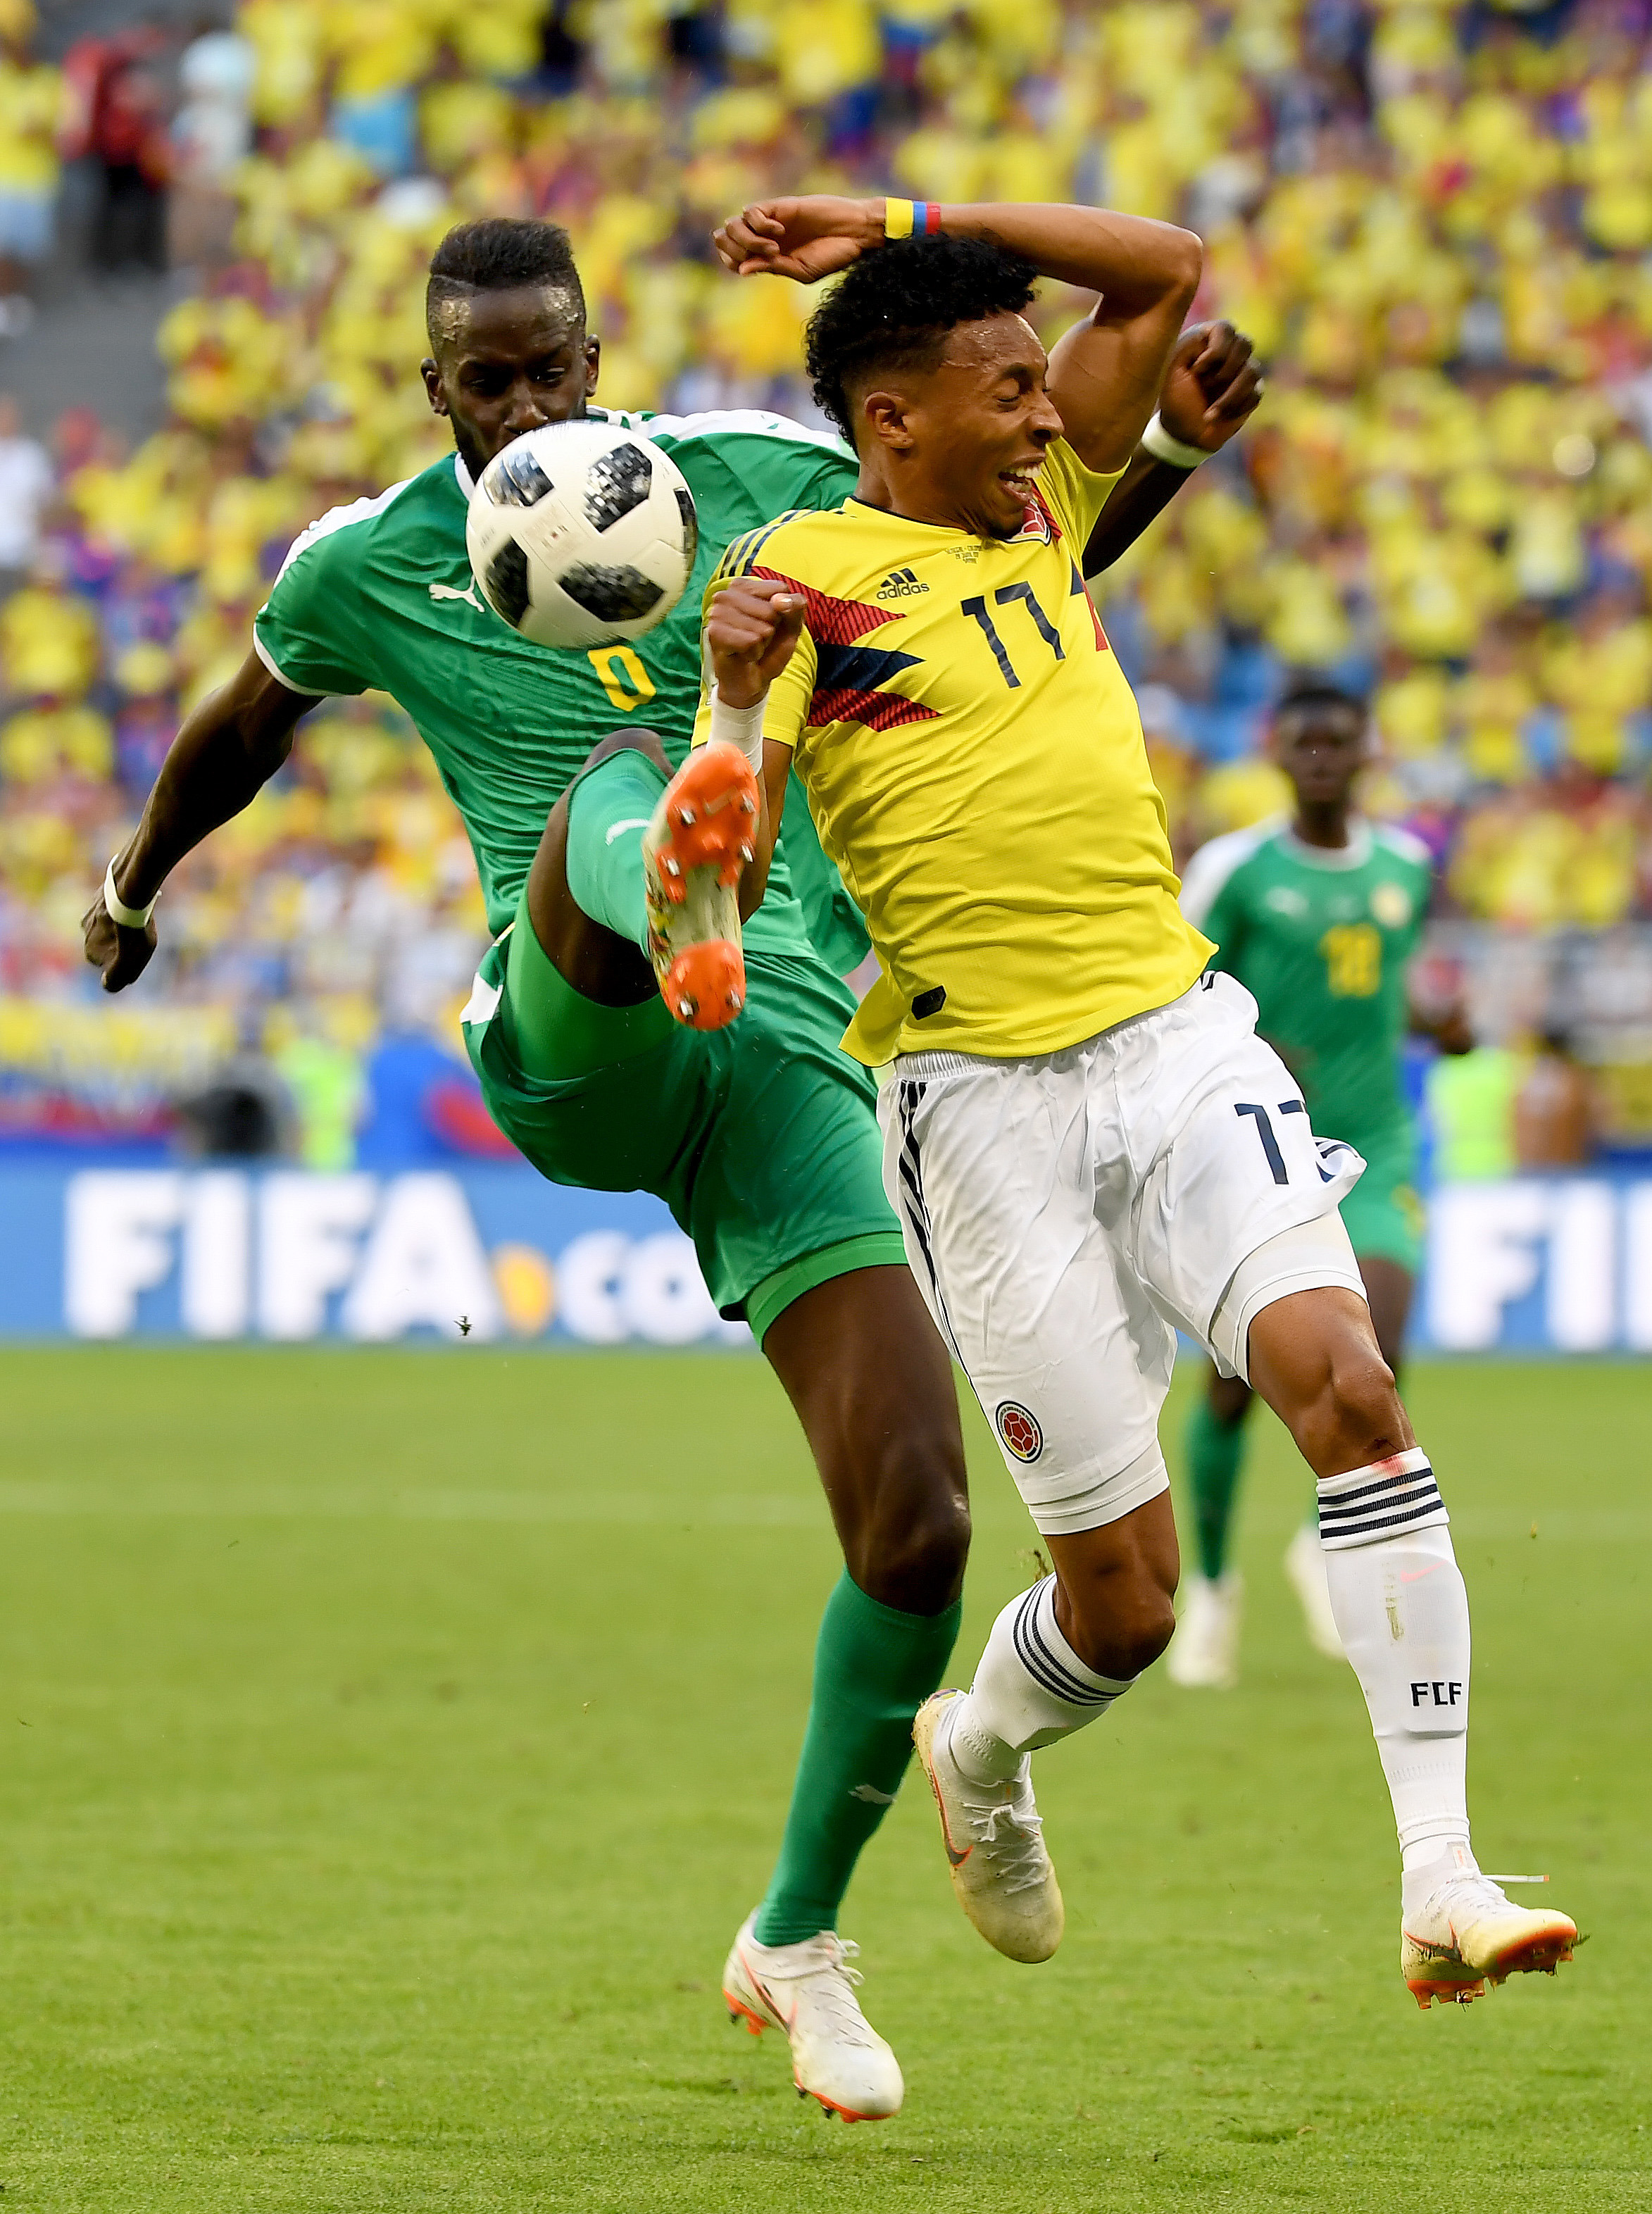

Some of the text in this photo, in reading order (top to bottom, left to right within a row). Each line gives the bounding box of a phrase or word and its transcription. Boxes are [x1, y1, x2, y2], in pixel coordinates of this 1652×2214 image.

[876, 582, 930, 600] adidas
[960, 580, 1067, 689] 17
[1427, 1179, 1652, 1351] FI
[1410, 1682, 1462, 1706] FCF
